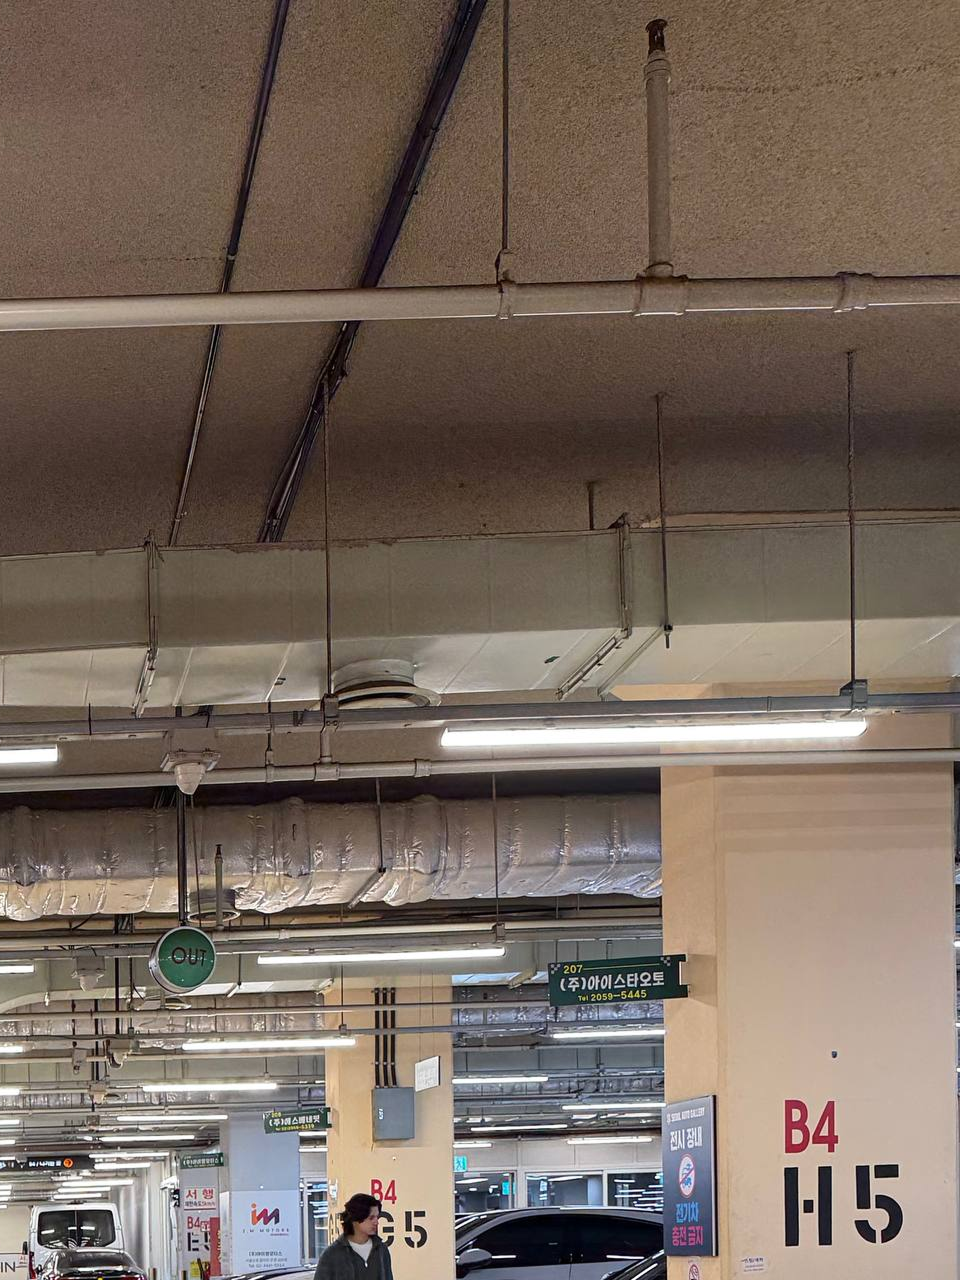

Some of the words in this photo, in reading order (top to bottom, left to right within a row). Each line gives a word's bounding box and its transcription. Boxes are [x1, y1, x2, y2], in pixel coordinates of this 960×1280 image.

[172, 946, 207, 967] OUT
[563, 965, 583, 974] 207
[560, 972, 665, 992] (주)아이스타오토
[591, 989, 647, 1002] 2059-5445
[784, 1099, 839, 1154] B4
[669, 1129, 685, 1151] 전시
[686, 1126, 703, 1149] 장내
[370, 1179, 398, 1205] B4
[187, 1216, 200, 1230] B4
[675, 1201, 699, 1224] 전기차
[671, 1225, 688, 1246] 충전
[688, 1225, 704, 1246] 금지
